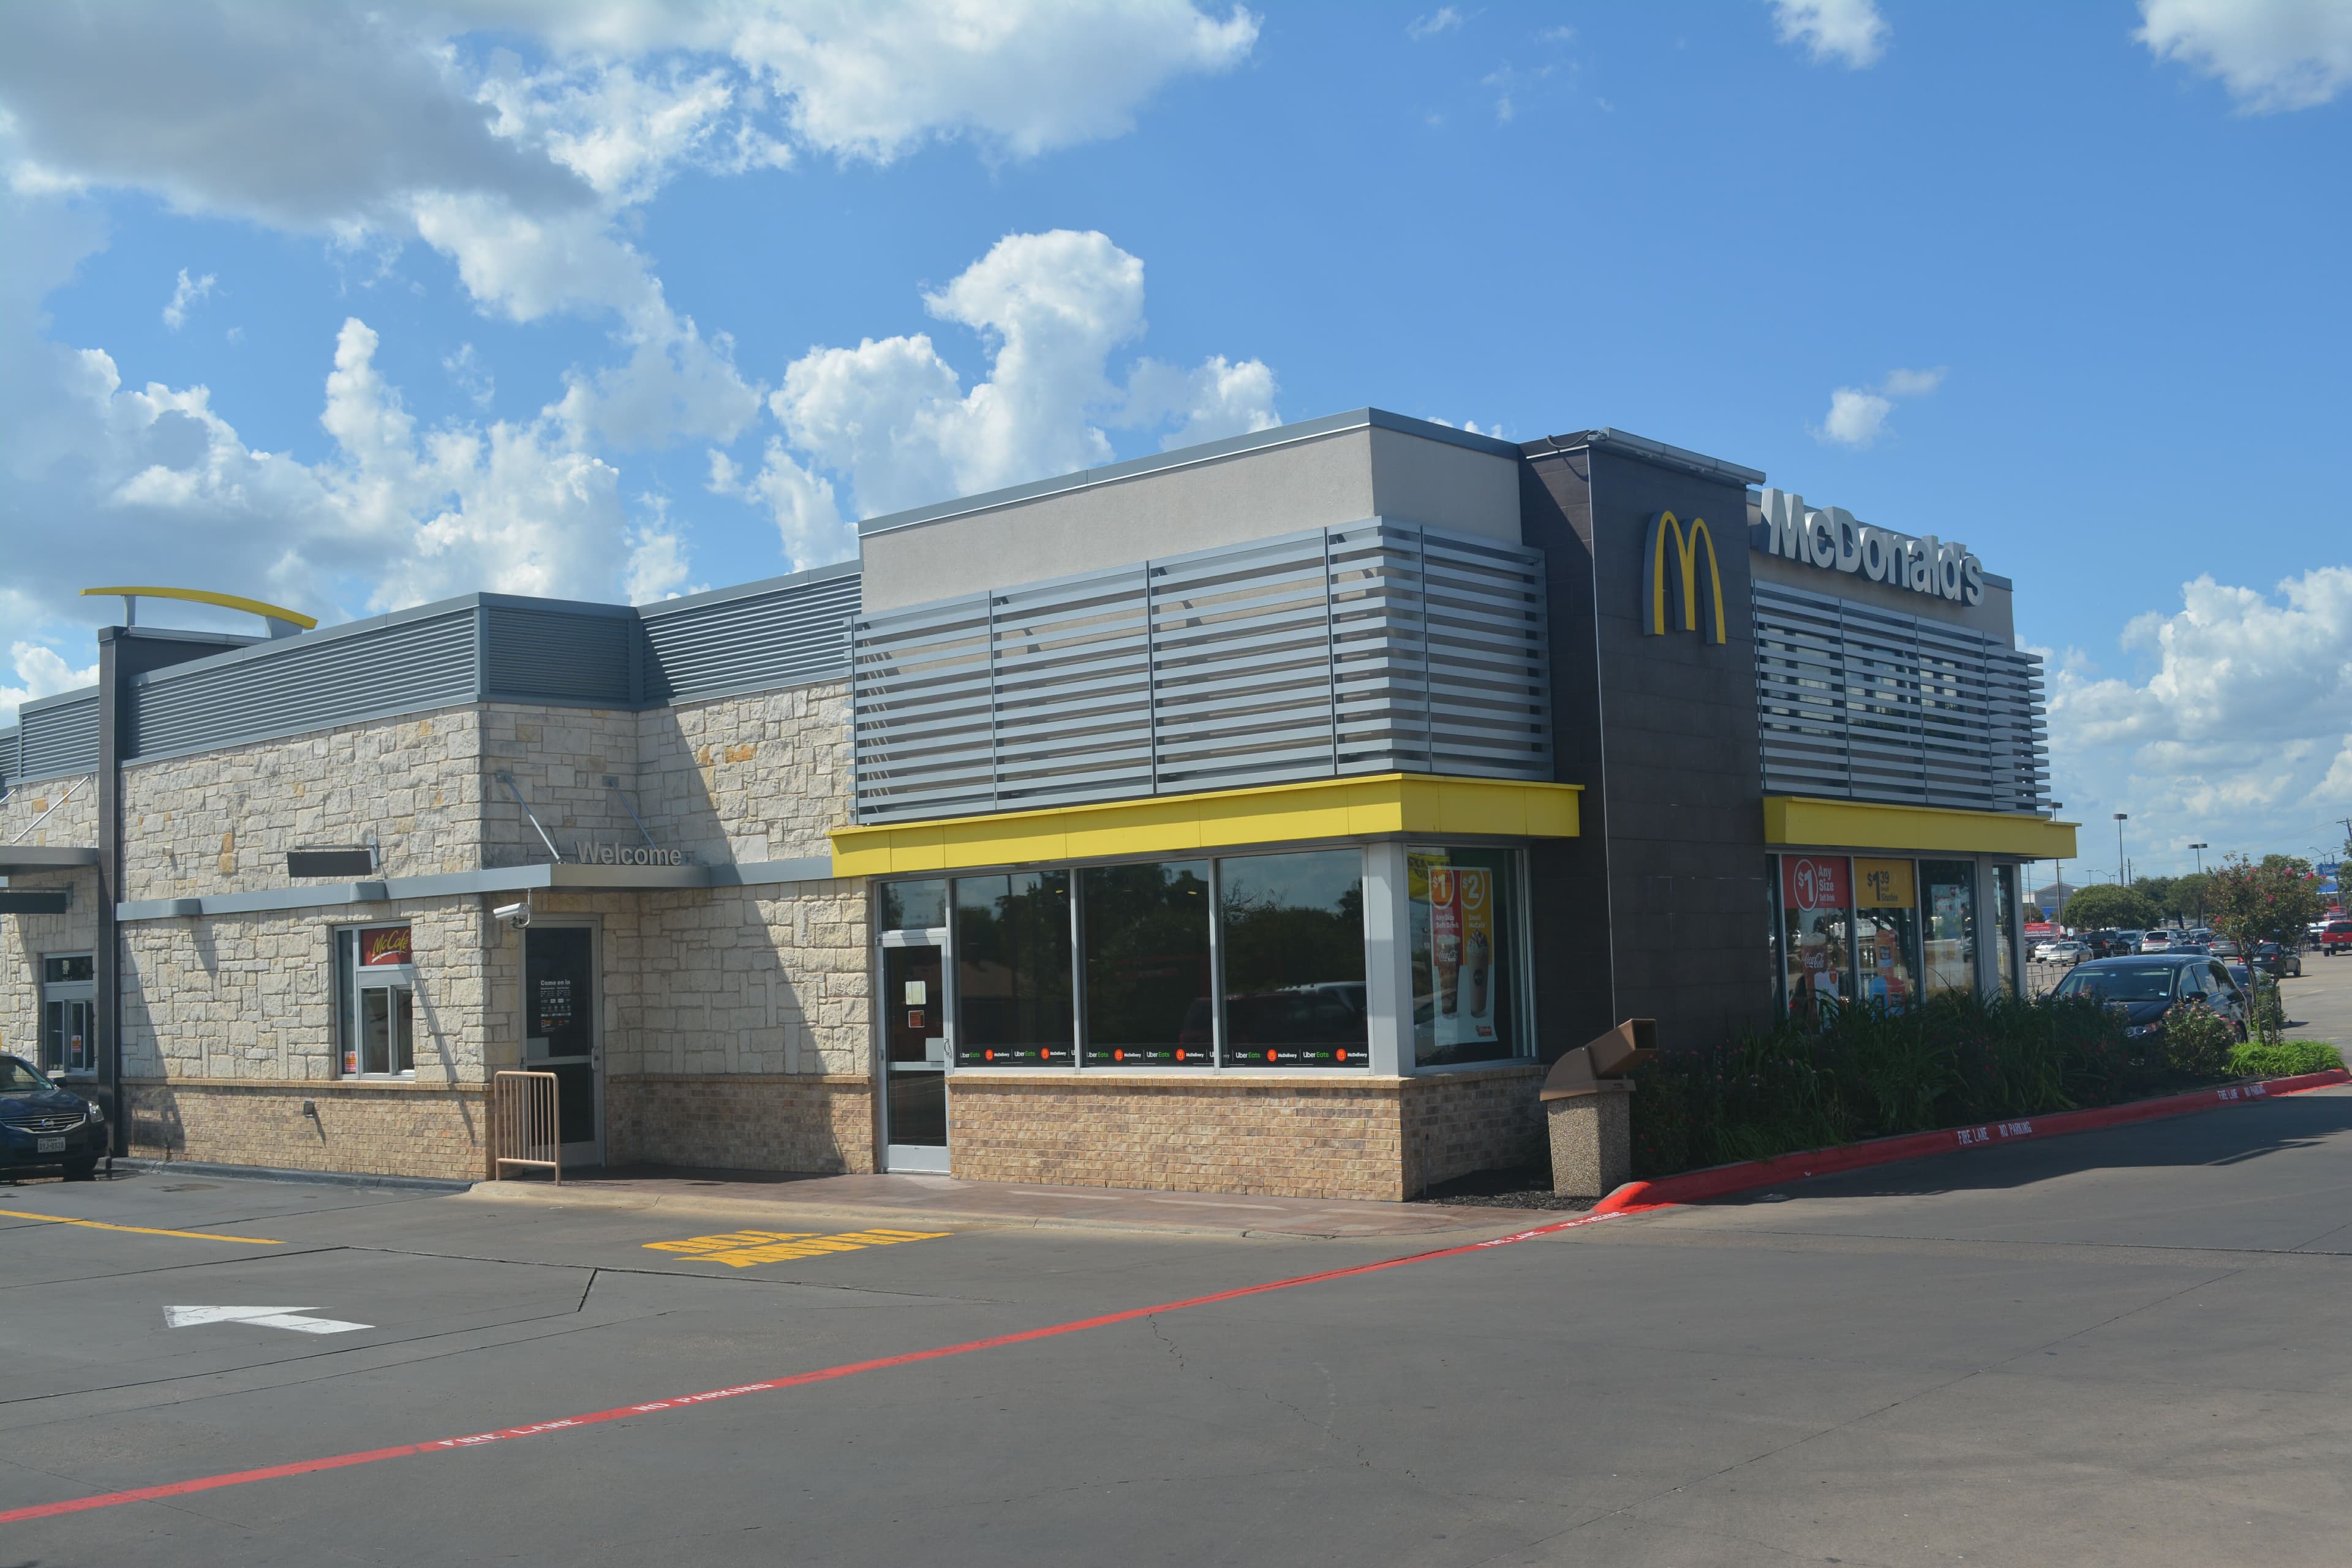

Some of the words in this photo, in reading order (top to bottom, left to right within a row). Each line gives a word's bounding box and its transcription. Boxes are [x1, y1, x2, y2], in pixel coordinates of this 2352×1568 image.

[1761, 488, 1985, 606] McDonald's
[575, 841, 682, 865] Welcome
[1798, 869, 1814, 902] $1
[1819, 865, 1832, 881] Any
[1819, 878, 1834, 892] Size
[1433, 873, 1446, 899] $1
[1462, 874, 1479, 899] $2
[372, 930, 409, 959] McCafé
[1957, 1130, 1973, 1145] FIRE
[1972, 1127, 1989, 1142] LANE
[1998, 1124, 2008, 1137] NO
[2008, 1121, 2032, 1136] PARKING
[437, 1433, 505, 1447] FIRE
[510, 1419, 584, 1434] LANE
[631, 1403, 670, 1411] NO
[675, 1382, 775, 1403] PARKING
